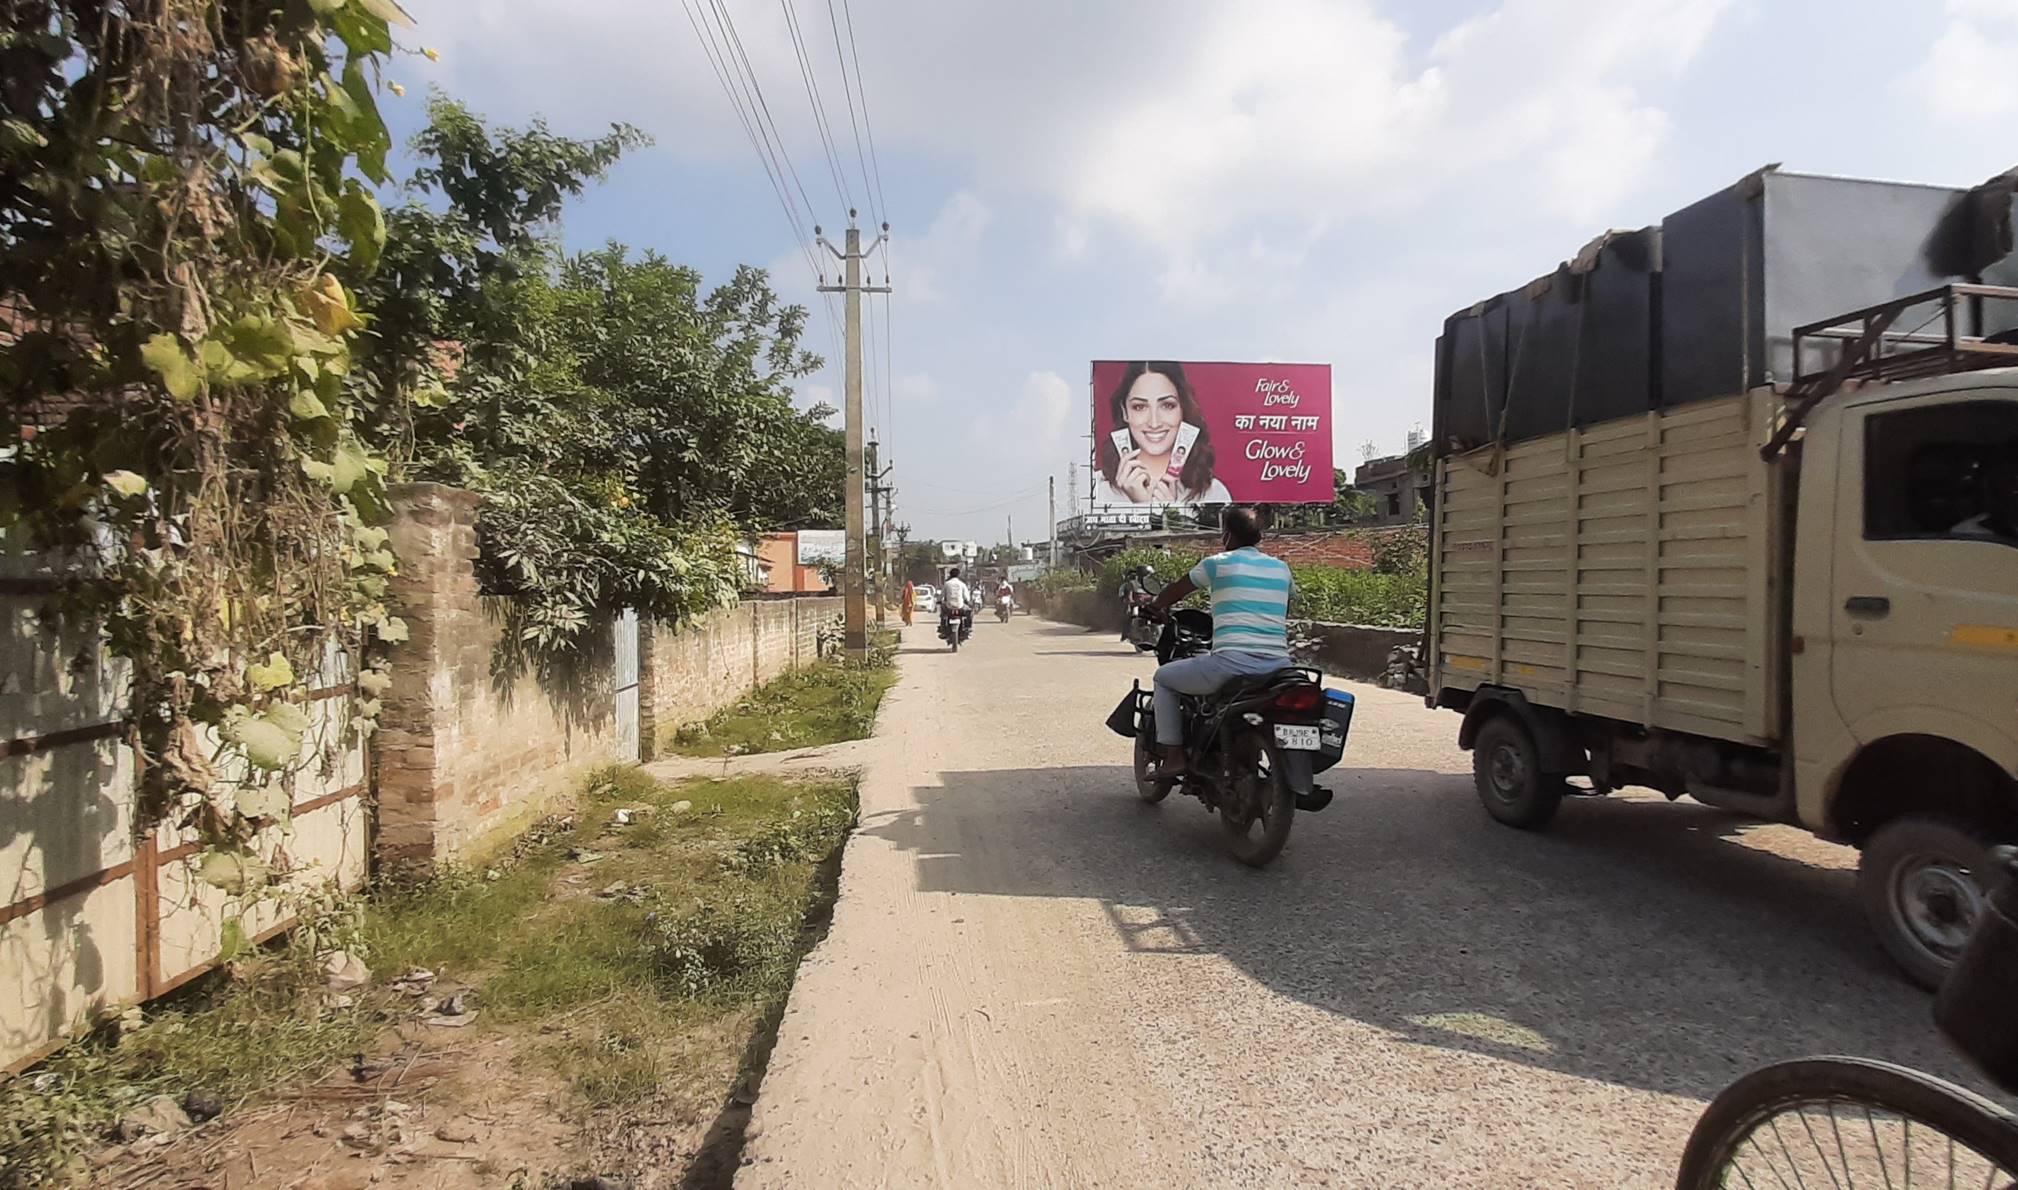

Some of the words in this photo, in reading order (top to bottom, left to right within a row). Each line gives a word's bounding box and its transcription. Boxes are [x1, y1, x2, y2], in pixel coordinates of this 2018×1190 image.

[1263, 390, 1300, 409] Lovely
[1235, 415, 1256, 430] का
[1259, 415, 1288, 430] नया
[1291, 416, 1320, 431] नाम
[1261, 459, 1312, 484] Lovely
